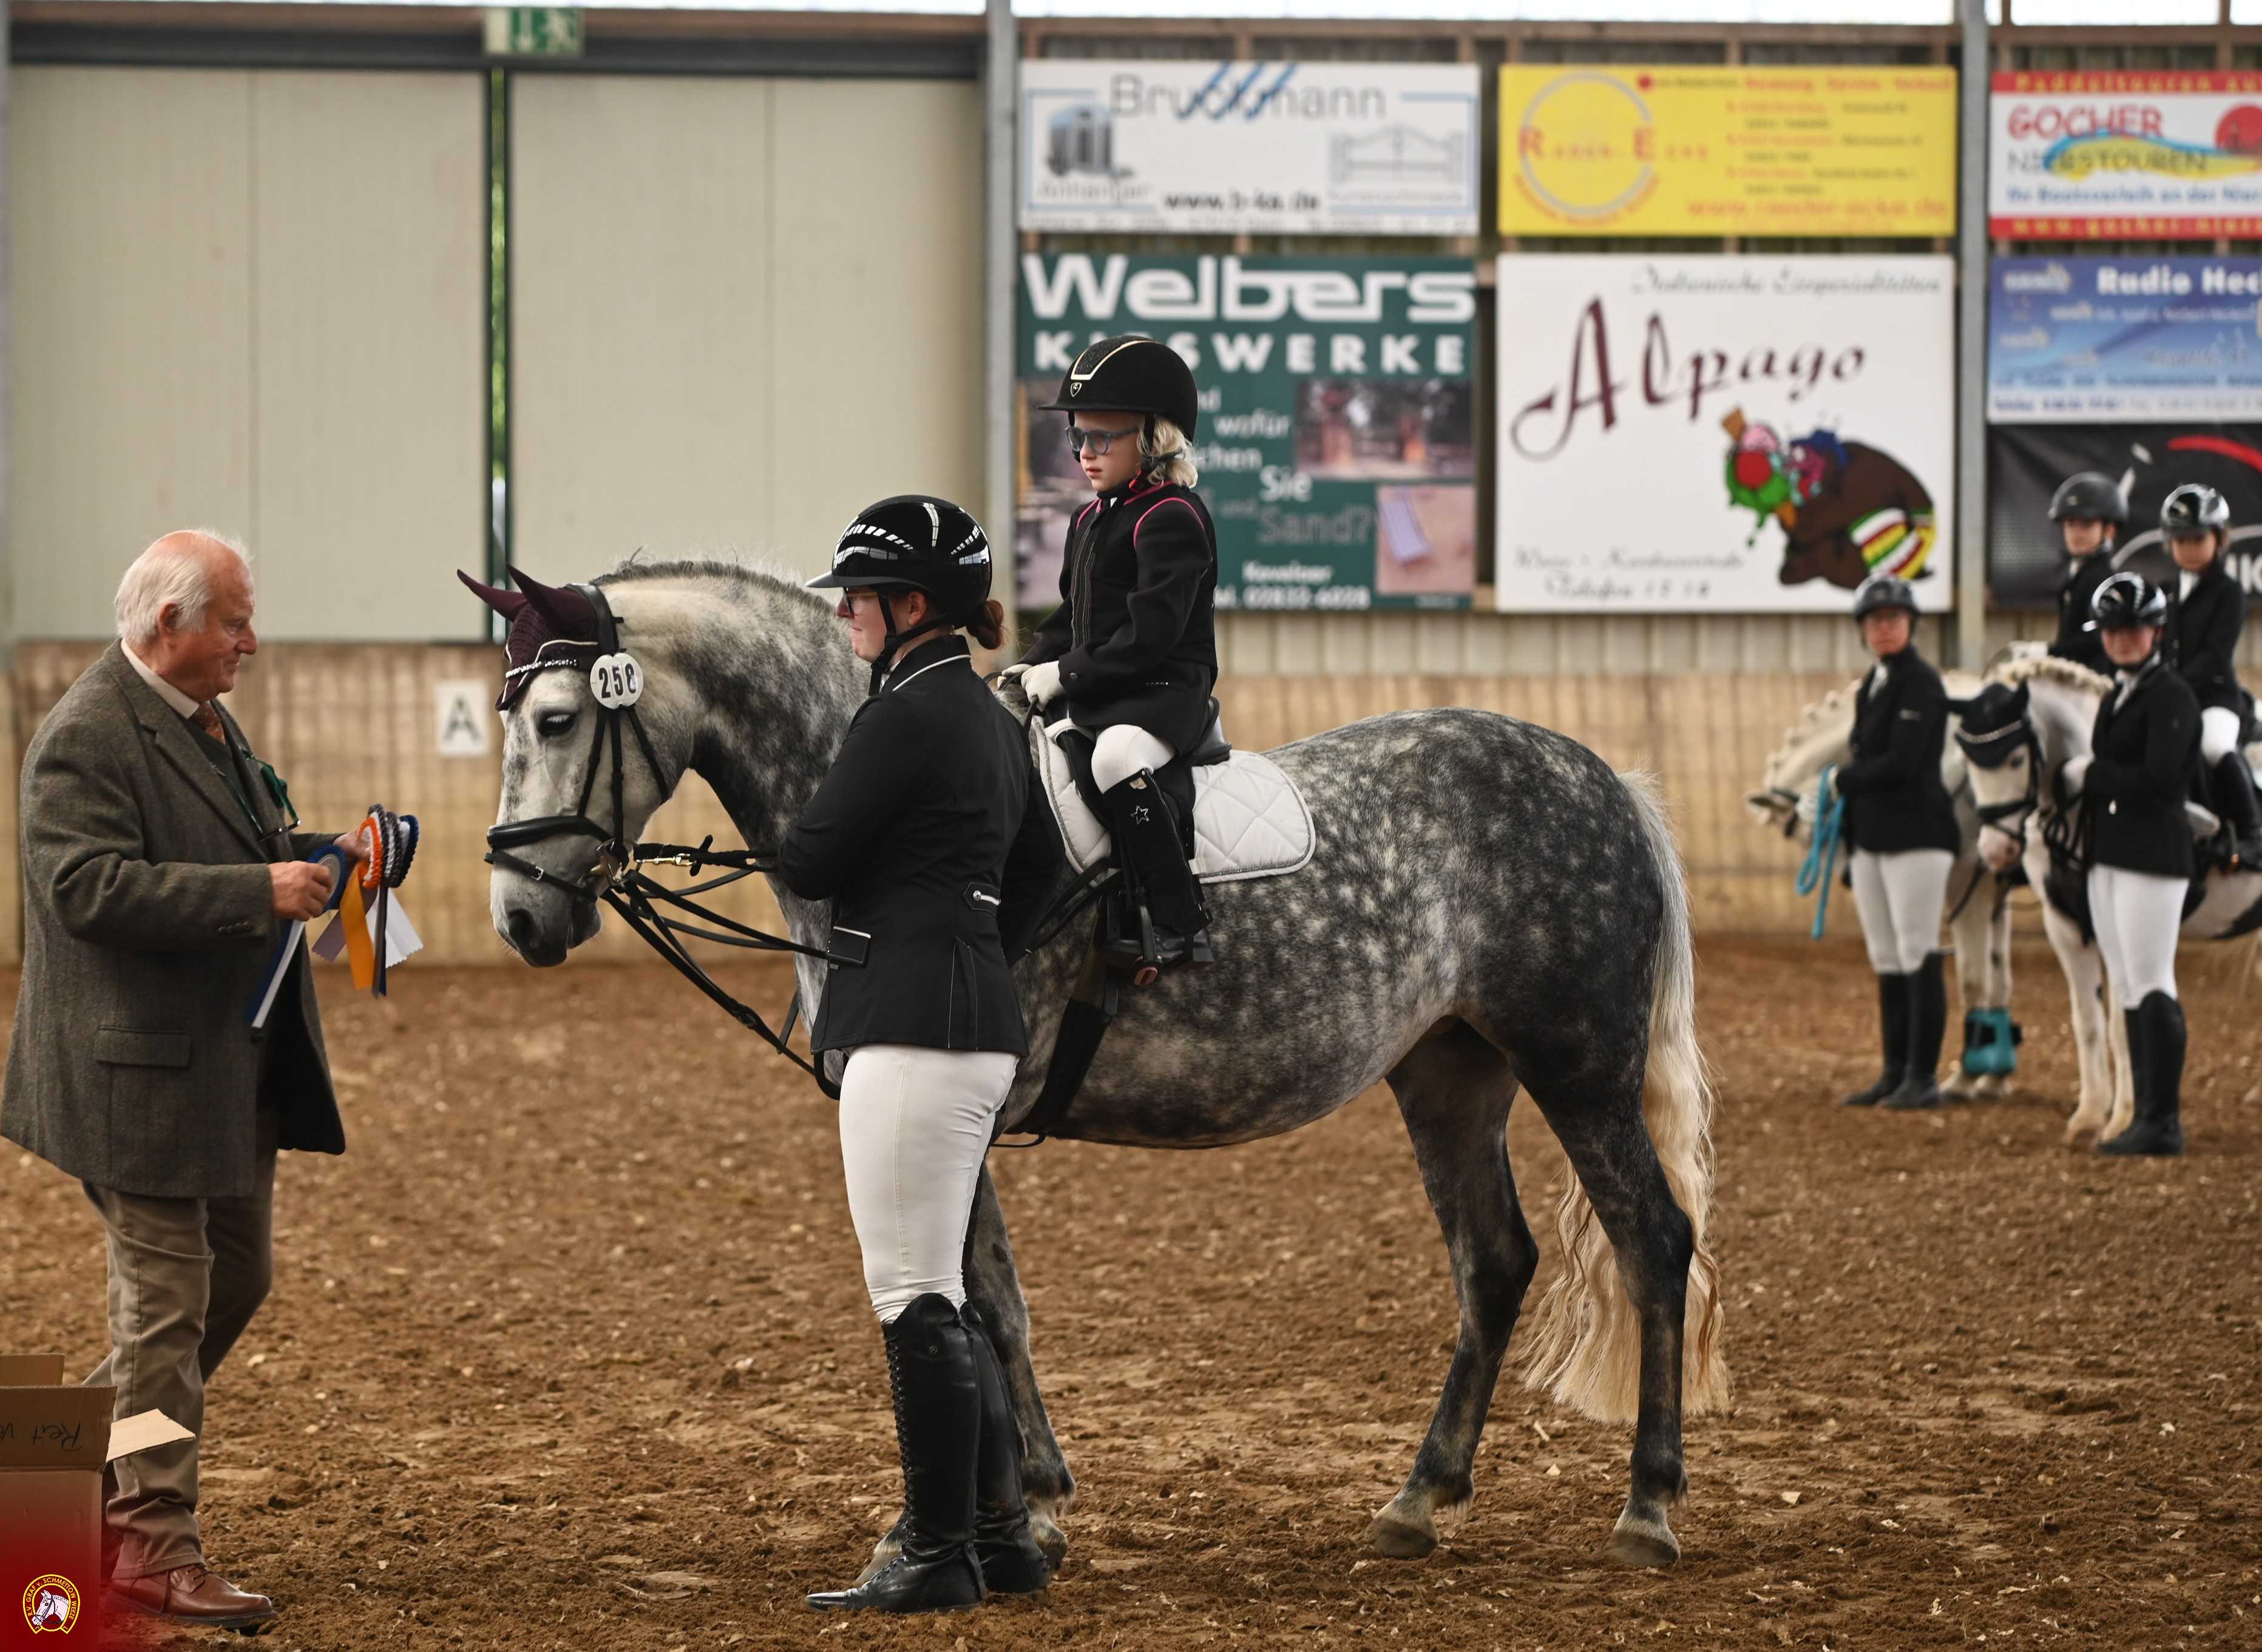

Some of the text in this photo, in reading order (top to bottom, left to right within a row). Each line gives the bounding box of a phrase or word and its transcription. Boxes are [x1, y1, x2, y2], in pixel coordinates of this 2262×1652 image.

[2227, 76, 2262, 92] au
[2008, 104, 2162, 140] GOCHER
[1164, 190, 1321, 212] www.b-ka.de
[1022, 253, 1475, 322] Welbers
[2098, 265, 2192, 295] Radio
[2202, 266, 2262, 295] Hec
[1036, 331, 1464, 374] KSWERKE
[1511, 297, 1865, 462] Alpago
[1214, 408, 1290, 438] wofür
[1260, 465, 1312, 502] Sie
[1259, 505, 1372, 544] Sand?
[444, 694, 481, 741] A
